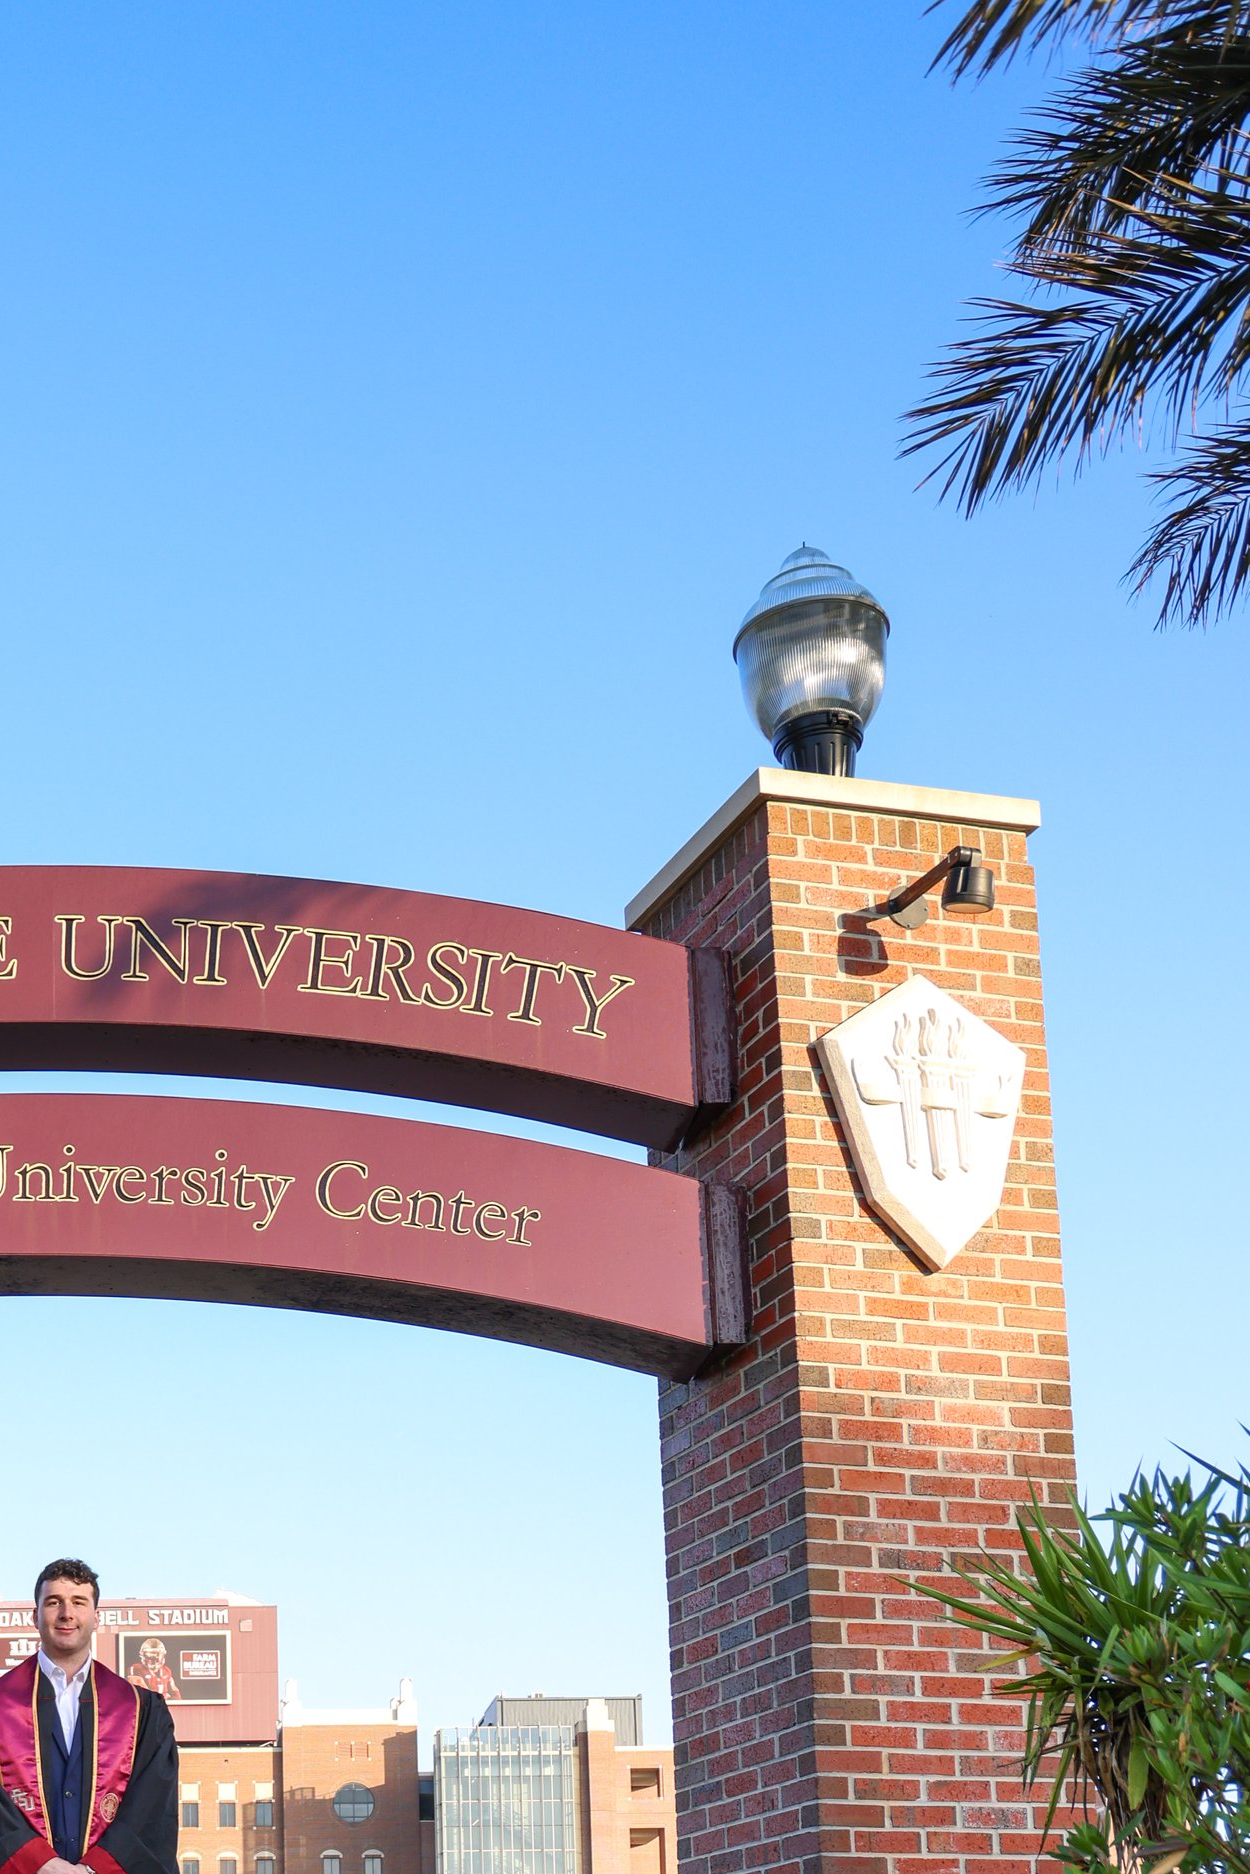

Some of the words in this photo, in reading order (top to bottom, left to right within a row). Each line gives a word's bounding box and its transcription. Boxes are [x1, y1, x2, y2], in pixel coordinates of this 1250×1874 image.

[55, 914, 635, 1040] UNIVERSITY
[315, 1160, 541, 1247] Center
[148, 1608, 229, 1625] STADIUM
[183, 1661, 217, 1669] BUREAU
[192, 1653, 216, 1662] FARM
[11, 1788, 35, 1812] FSU
